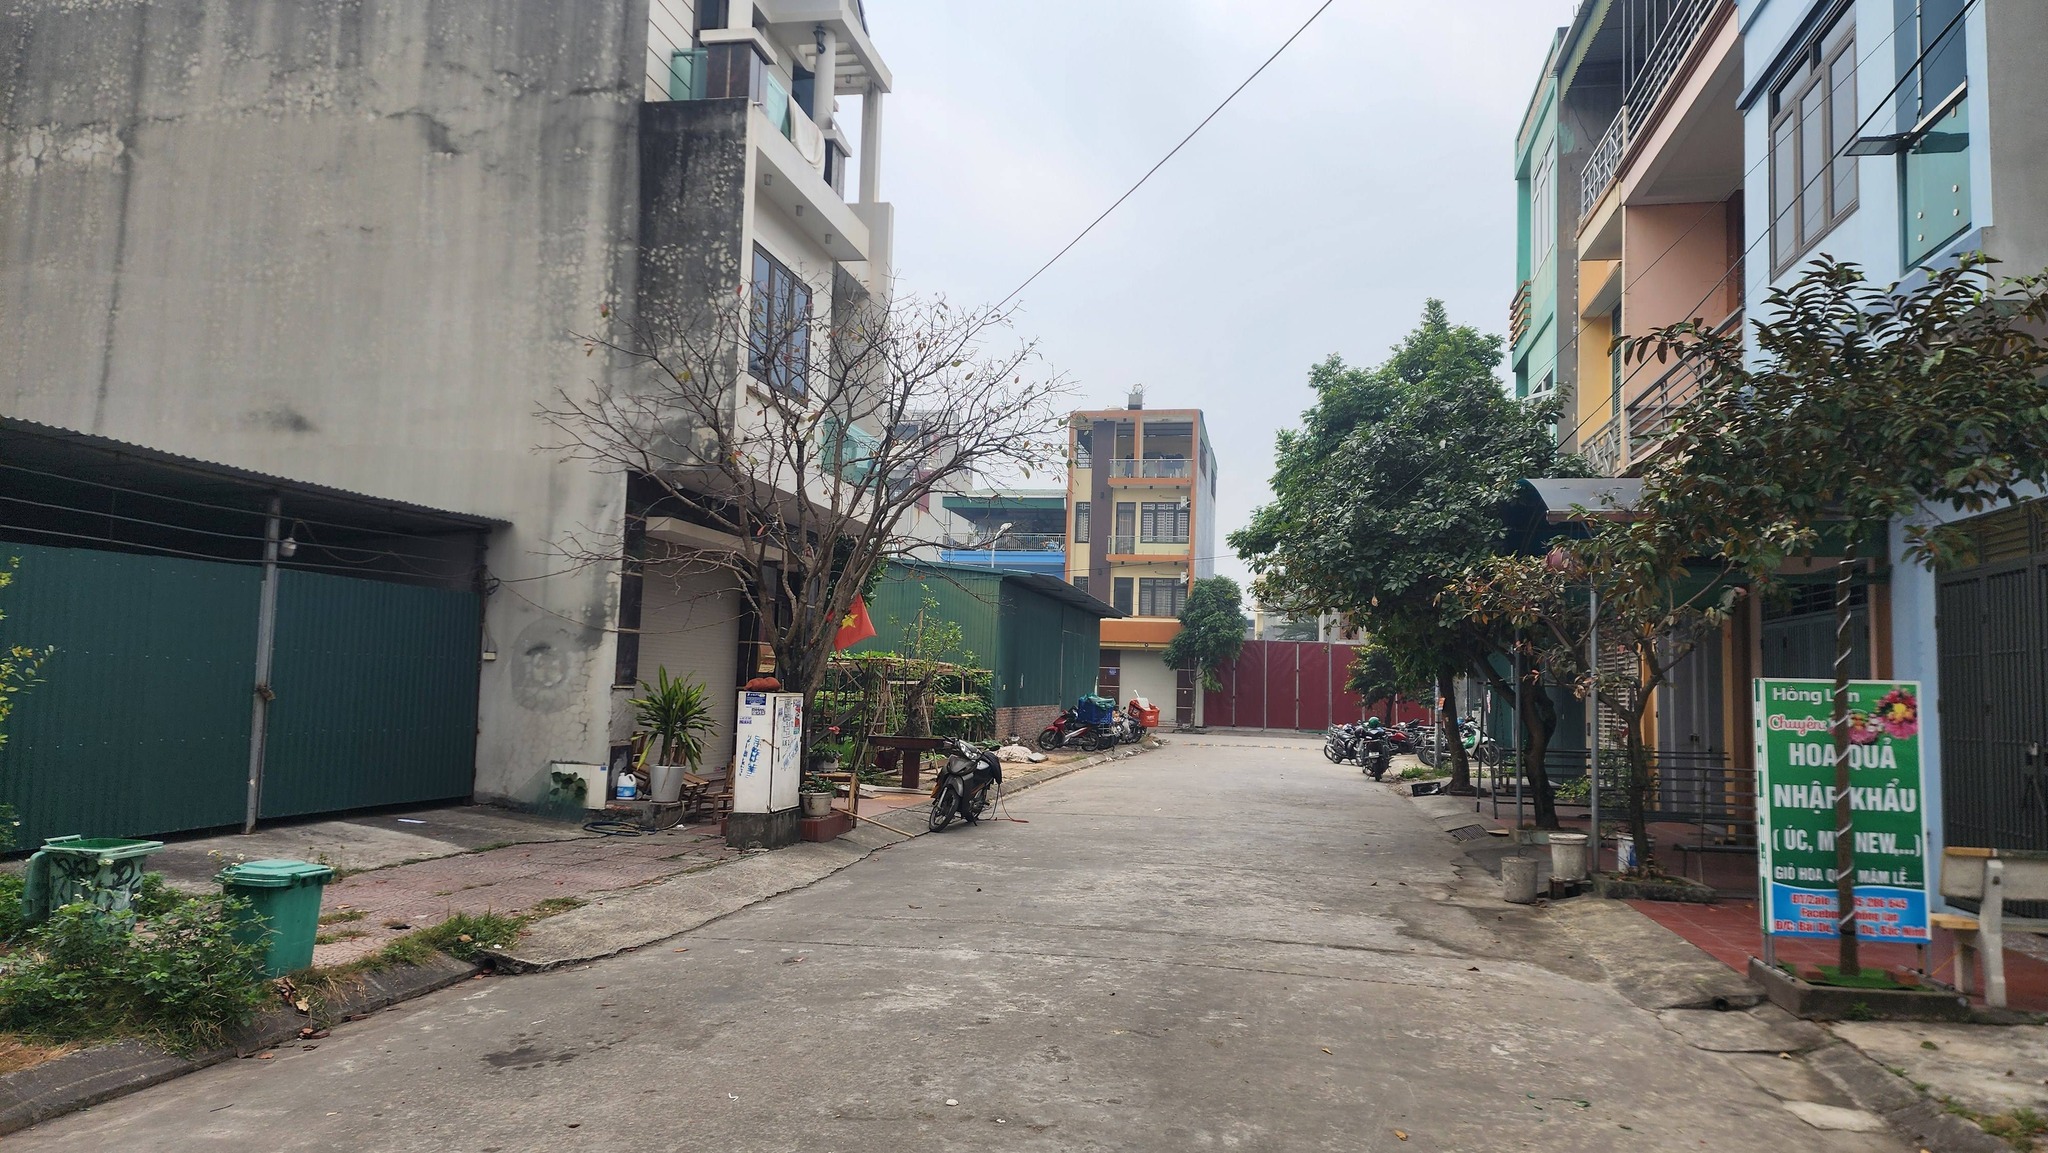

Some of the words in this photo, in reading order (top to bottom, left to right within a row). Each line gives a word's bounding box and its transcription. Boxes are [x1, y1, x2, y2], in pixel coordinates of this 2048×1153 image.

[1825, 687, 1860, 703] Ln
[1788, 742, 1838, 767] HOA
[1848, 737, 1898, 770] QUẢ
[1850, 778, 1917, 813] KHẨU
[1798, 866, 1823, 882] HOA
[1857, 867, 1890, 884] MÂM
